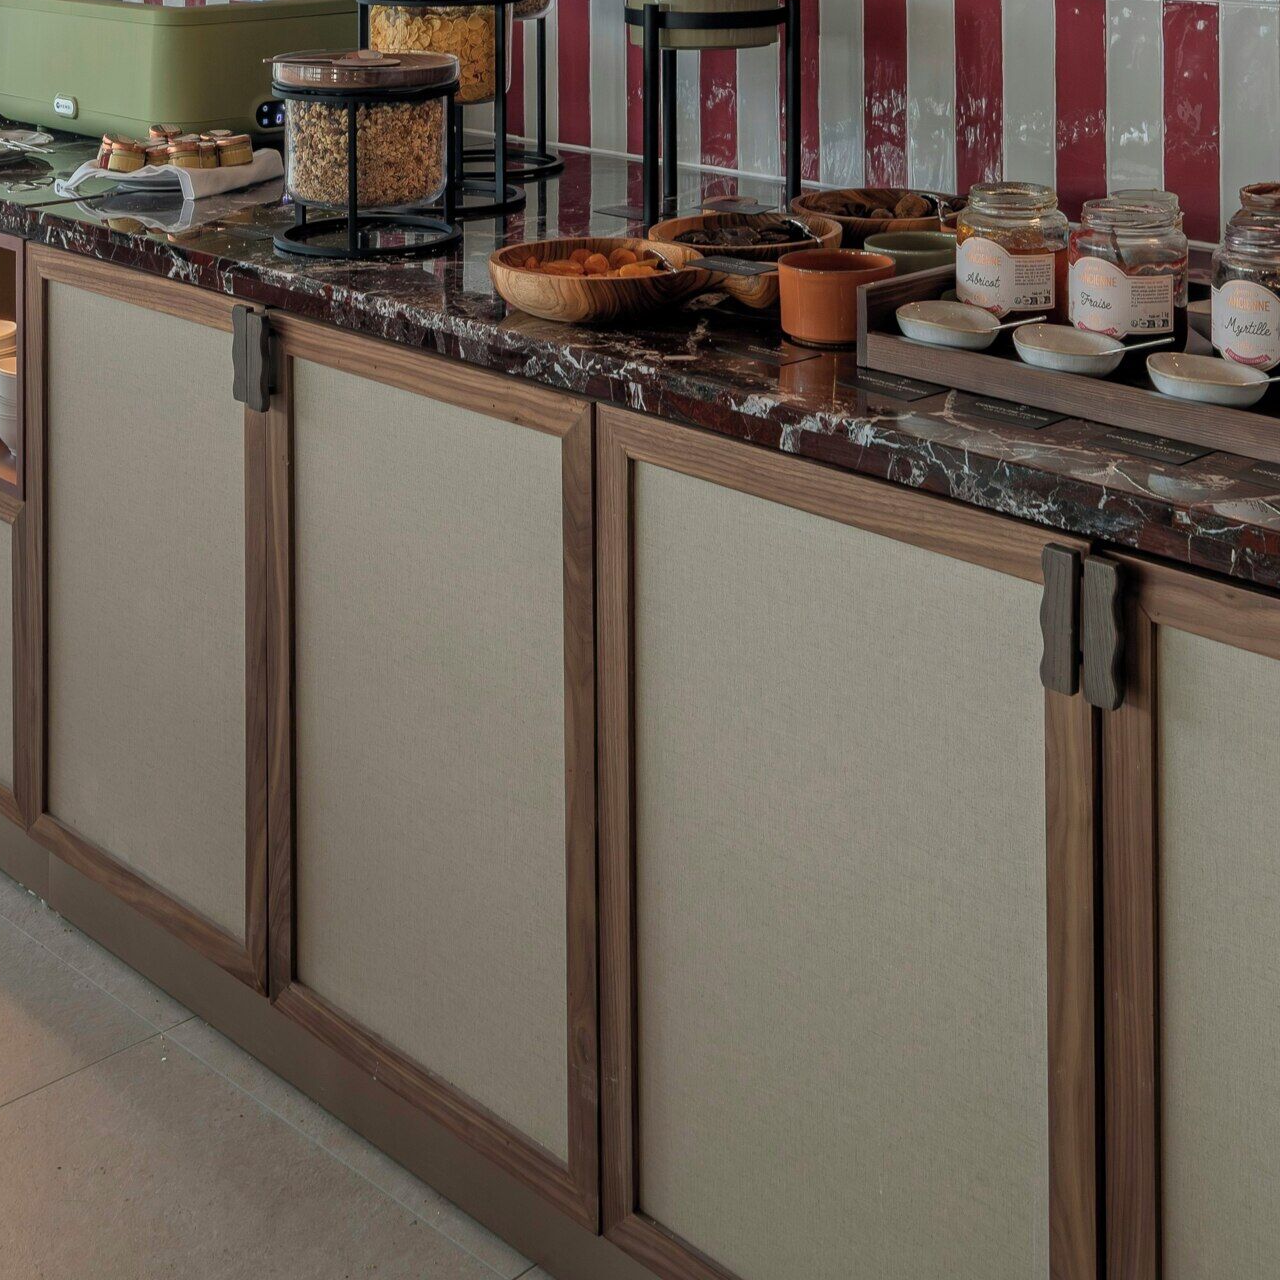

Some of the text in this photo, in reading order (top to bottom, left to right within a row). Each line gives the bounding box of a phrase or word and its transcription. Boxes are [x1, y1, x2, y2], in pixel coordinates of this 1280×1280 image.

[966, 271, 1001, 288] Abricot
[1080, 291, 1112, 310] Fraise
[1224, 316, 1271, 337] Myrtille
